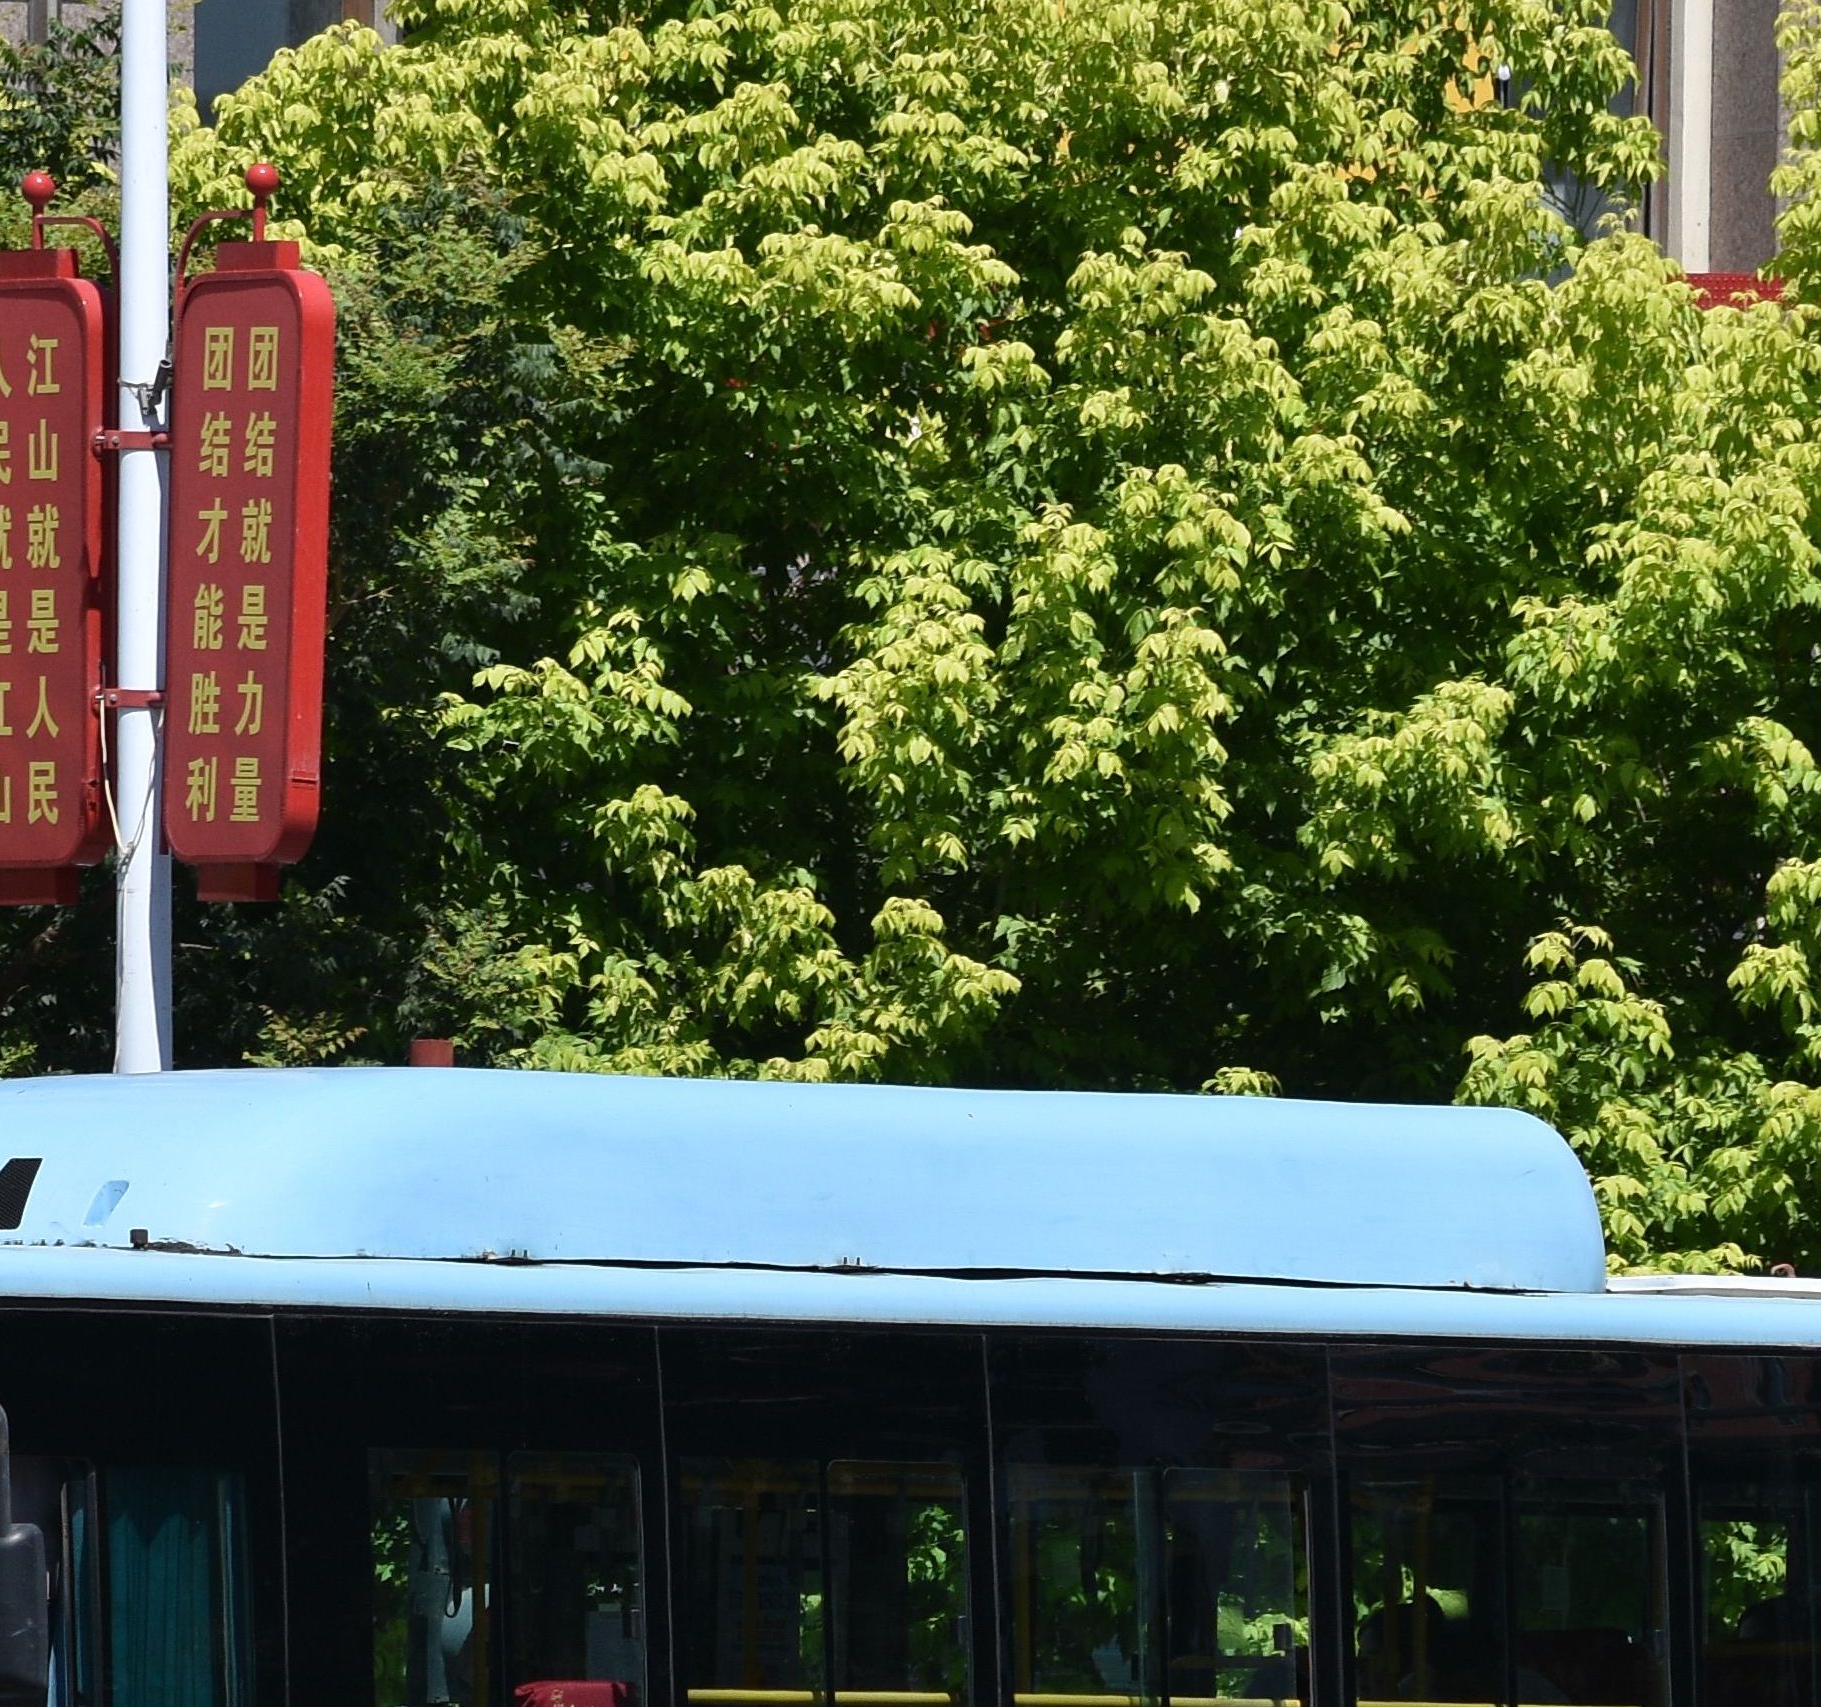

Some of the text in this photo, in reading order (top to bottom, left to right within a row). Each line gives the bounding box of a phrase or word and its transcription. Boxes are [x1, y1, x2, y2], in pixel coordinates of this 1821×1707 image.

[26, 333, 61, 825] 江山就是人民
[185, 326, 235, 823] 团结才能胜利
[229, 325, 280, 823] 团结就是力量
